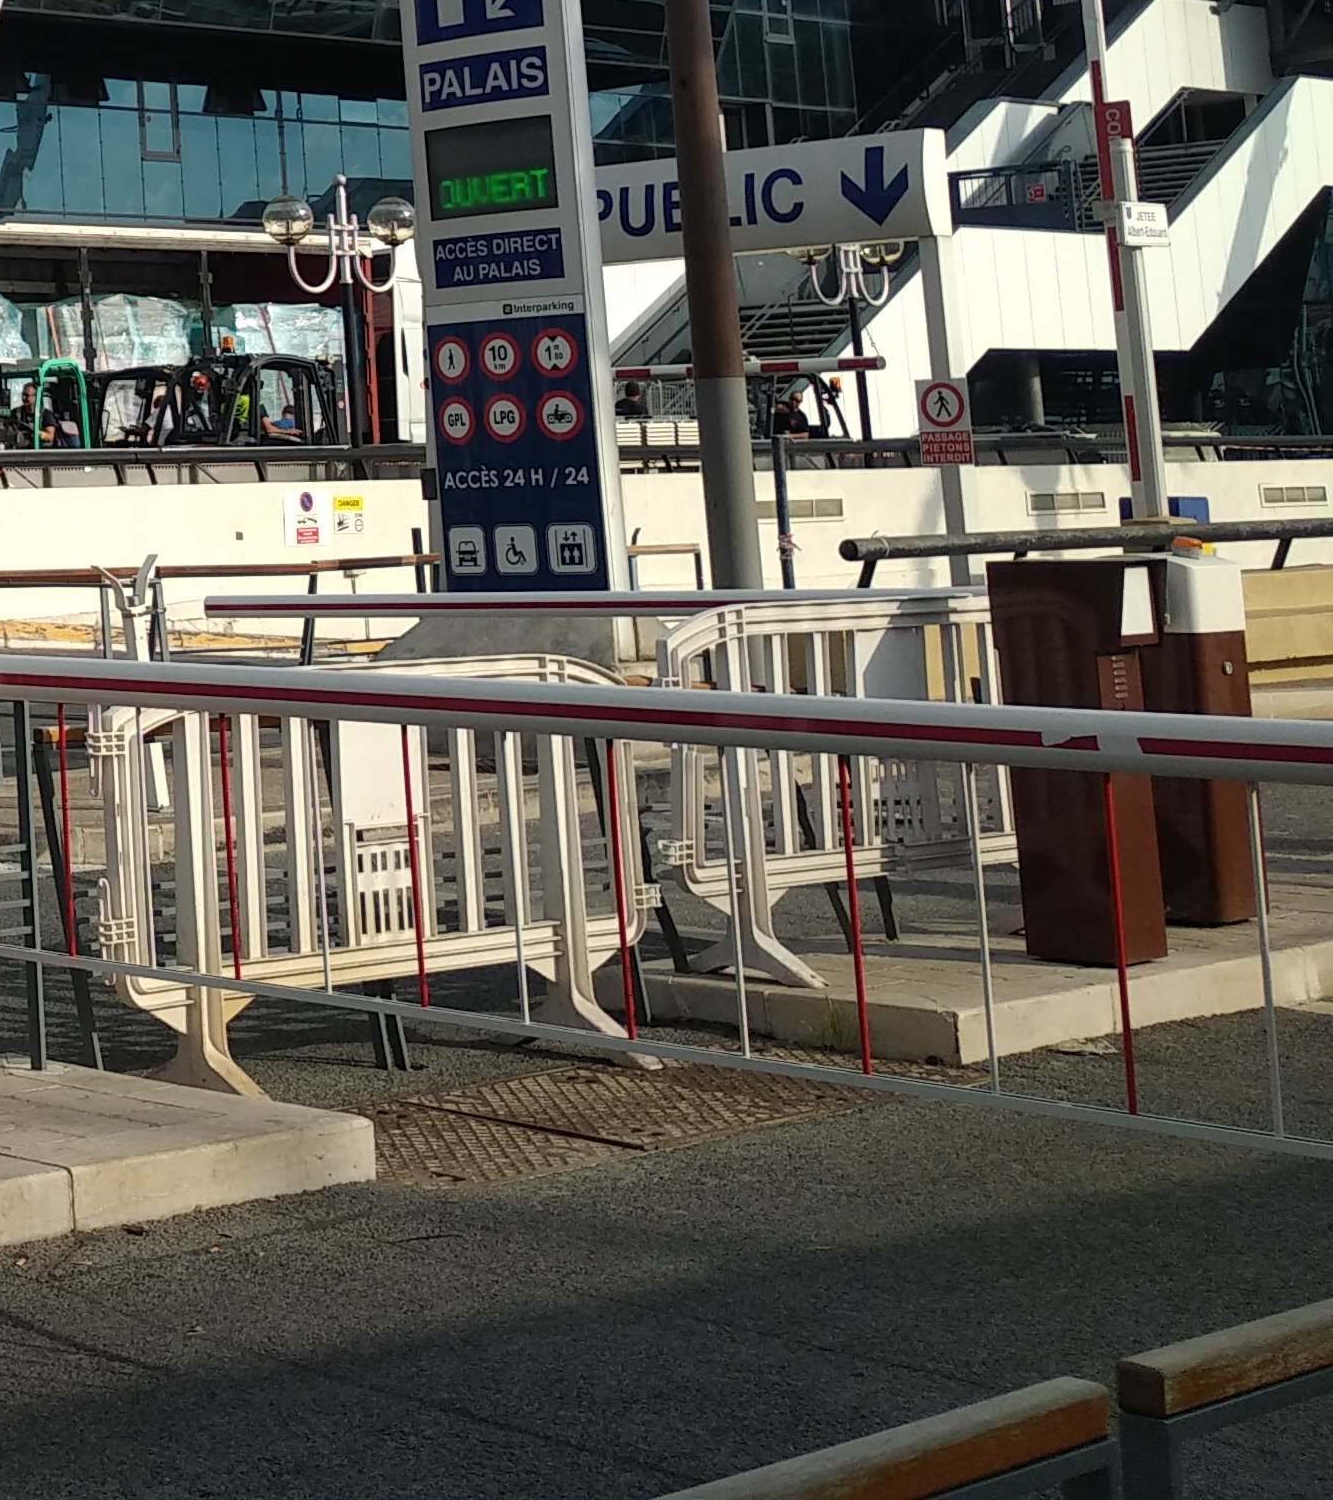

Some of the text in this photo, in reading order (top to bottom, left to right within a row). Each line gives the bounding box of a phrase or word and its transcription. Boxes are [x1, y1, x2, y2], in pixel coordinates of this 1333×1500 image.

[422, 55, 545, 104] PALAIS
[439, 166, 550, 210] OUVERT
[435, 233, 560, 261] ACCÈS DIRECT
[452, 259, 542, 282] AU PALAIS
[513, 301, 575, 315] Interparking
[488, 345, 508, 362] 10
[447, 409, 466, 427] GPL
[493, 409, 516, 425] LPG
[921, 431, 969, 442] PASSAGE
[922, 442, 970, 452] PIETONS
[923, 452, 971, 463] INTERDIT
[443, 465, 589, 490] ACCÈS 24 H / 24
[337, 499, 360, 507] DANGER
